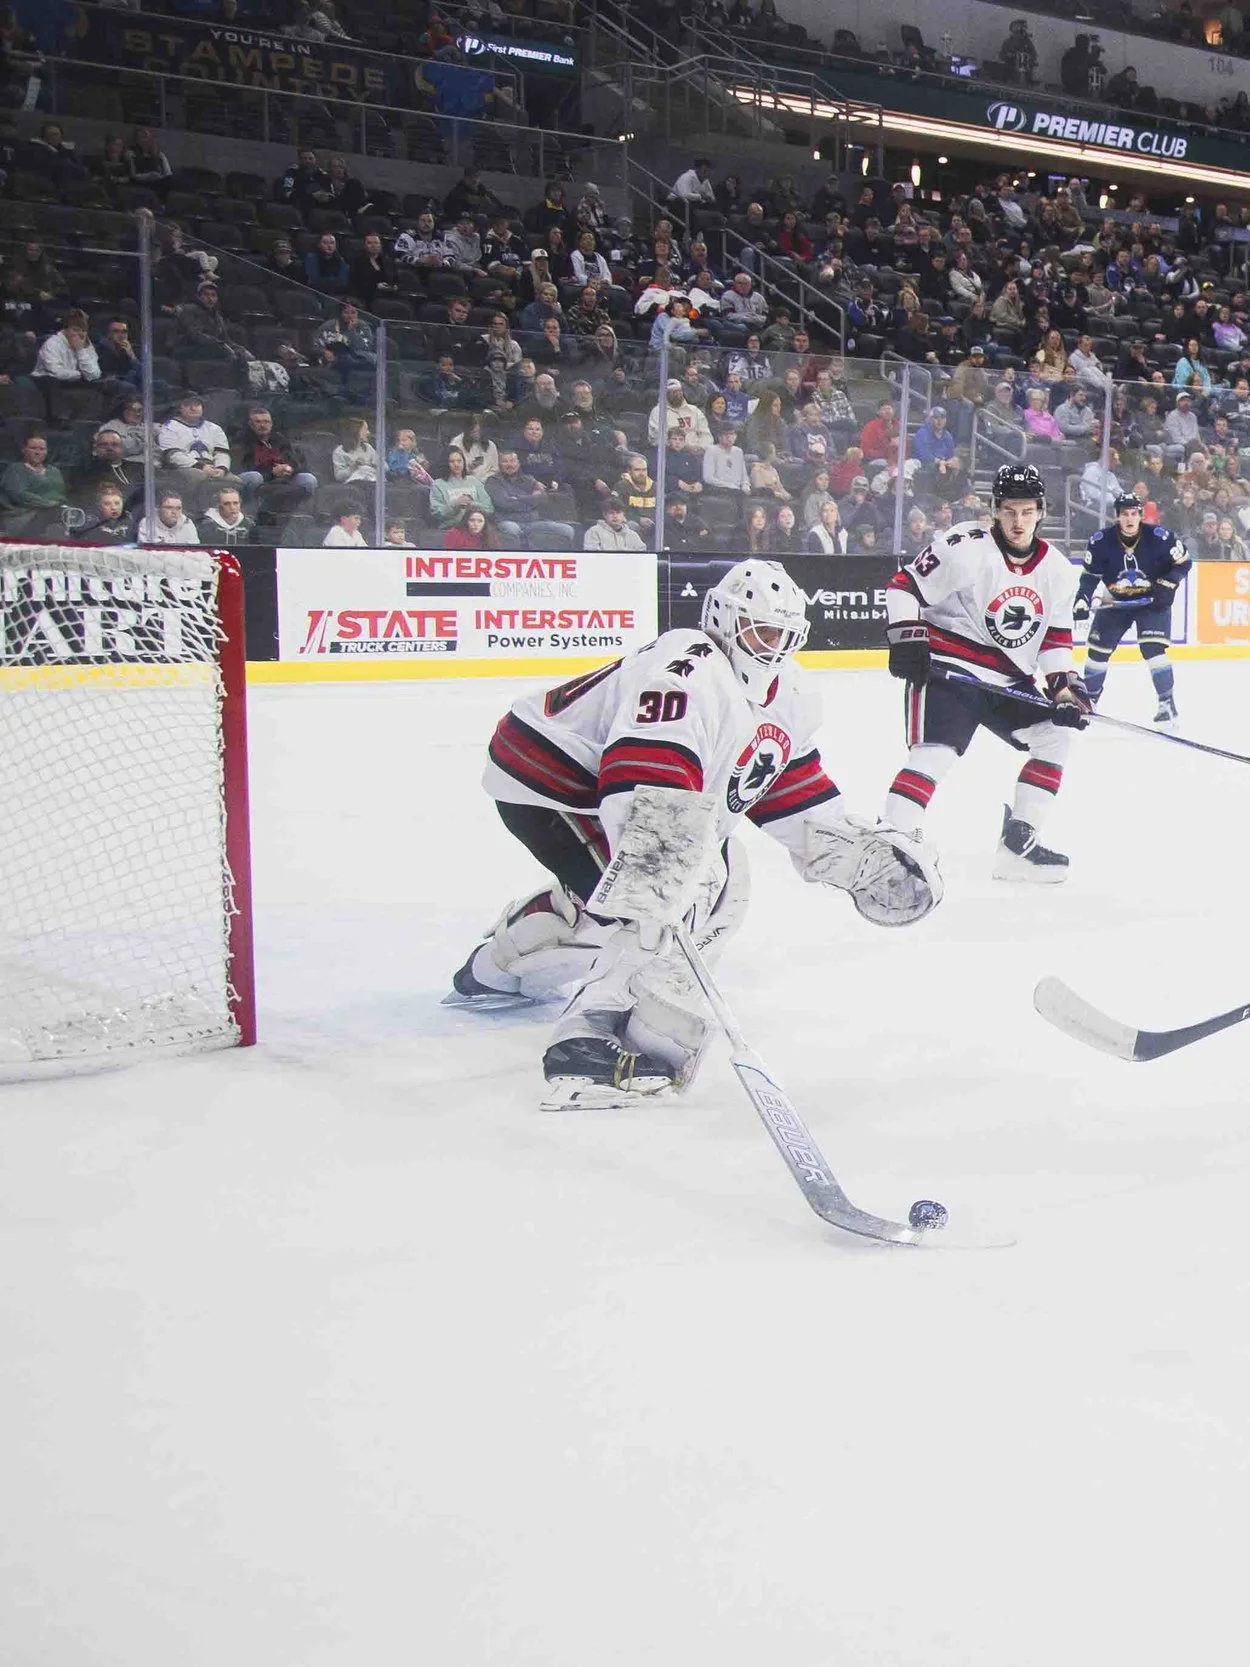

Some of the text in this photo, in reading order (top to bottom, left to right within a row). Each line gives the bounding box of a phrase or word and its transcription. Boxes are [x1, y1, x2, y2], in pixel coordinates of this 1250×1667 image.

[290, 42, 309, 55] IN
[1032, 112, 1188, 159] PREMIER CLUB
[405, 556, 578, 579] INTERSTATE
[801, 588, 864, 607] Vern
[335, 608, 459, 640] STATE
[474, 609, 635, 630] INTERSTATE
[338, 639, 449, 654] TRUCK CENTERS
[487, 633, 623, 650] Power Systems
[635, 689, 689, 723] 30
